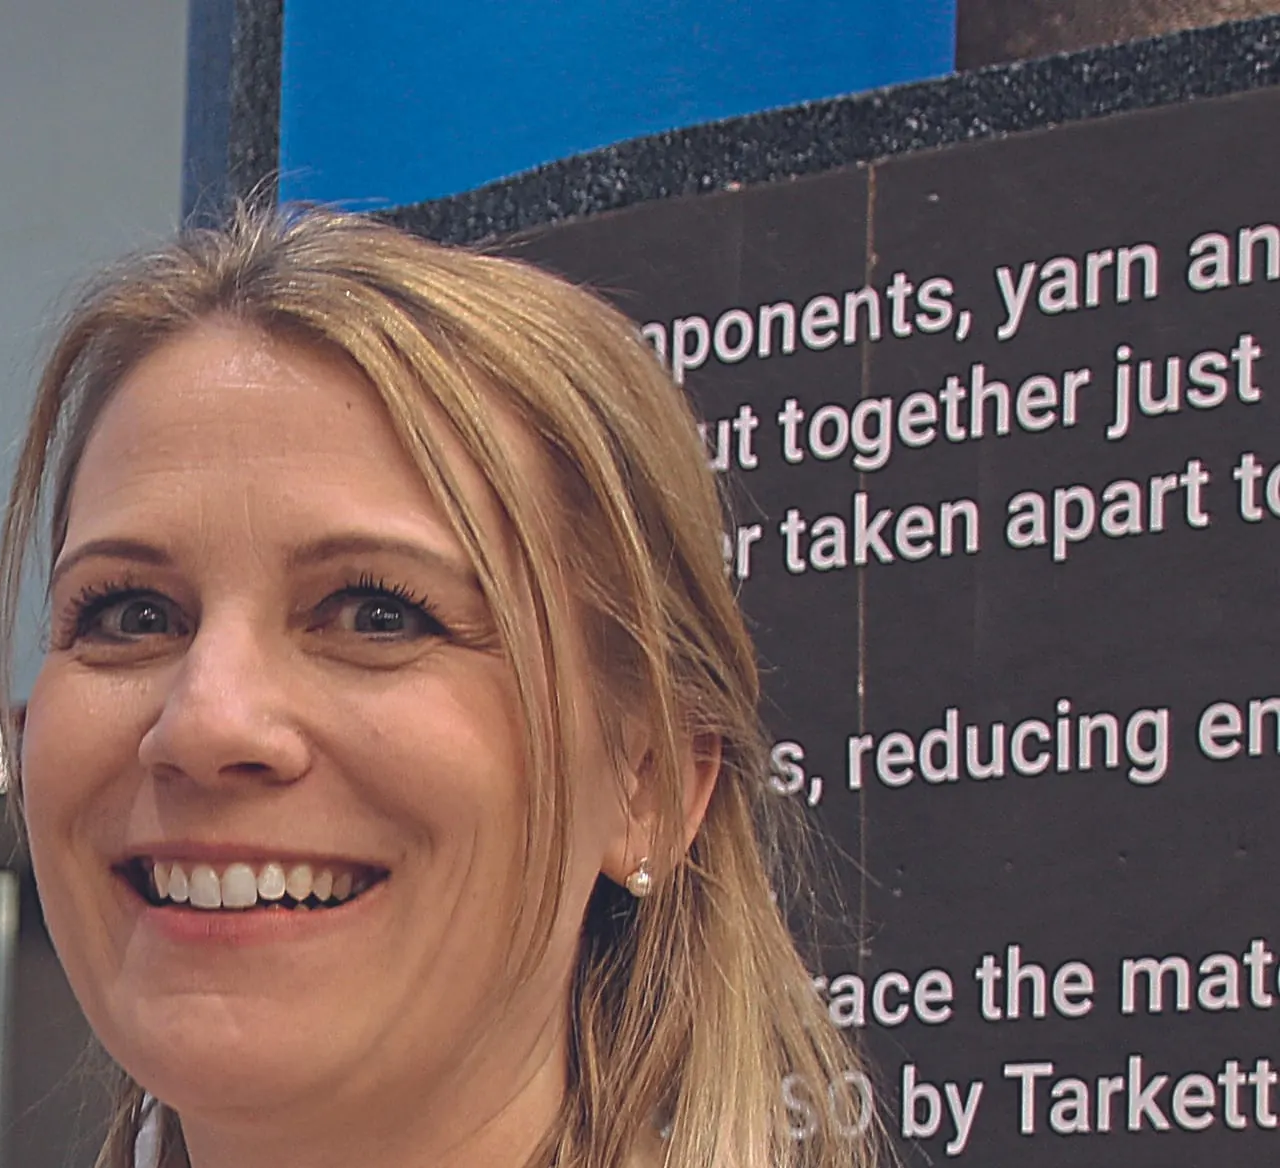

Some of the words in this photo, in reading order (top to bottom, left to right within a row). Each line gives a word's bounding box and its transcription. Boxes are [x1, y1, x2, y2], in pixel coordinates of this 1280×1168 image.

[997, 245, 1158, 340] yarn
[1188, 225, 1280, 290] an
[779, 364, 1090, 470] together
[1107, 334, 1261, 439] just
[781, 493, 979, 571] taken
[1006, 460, 1209, 561] apart
[849, 699, 1169, 789] reducing
[976, 945, 1094, 1020] the
[1121, 940, 1280, 1013] mat
[902, 1064, 984, 1155] by
[1004, 1055, 1278, 1134] Tarkett
